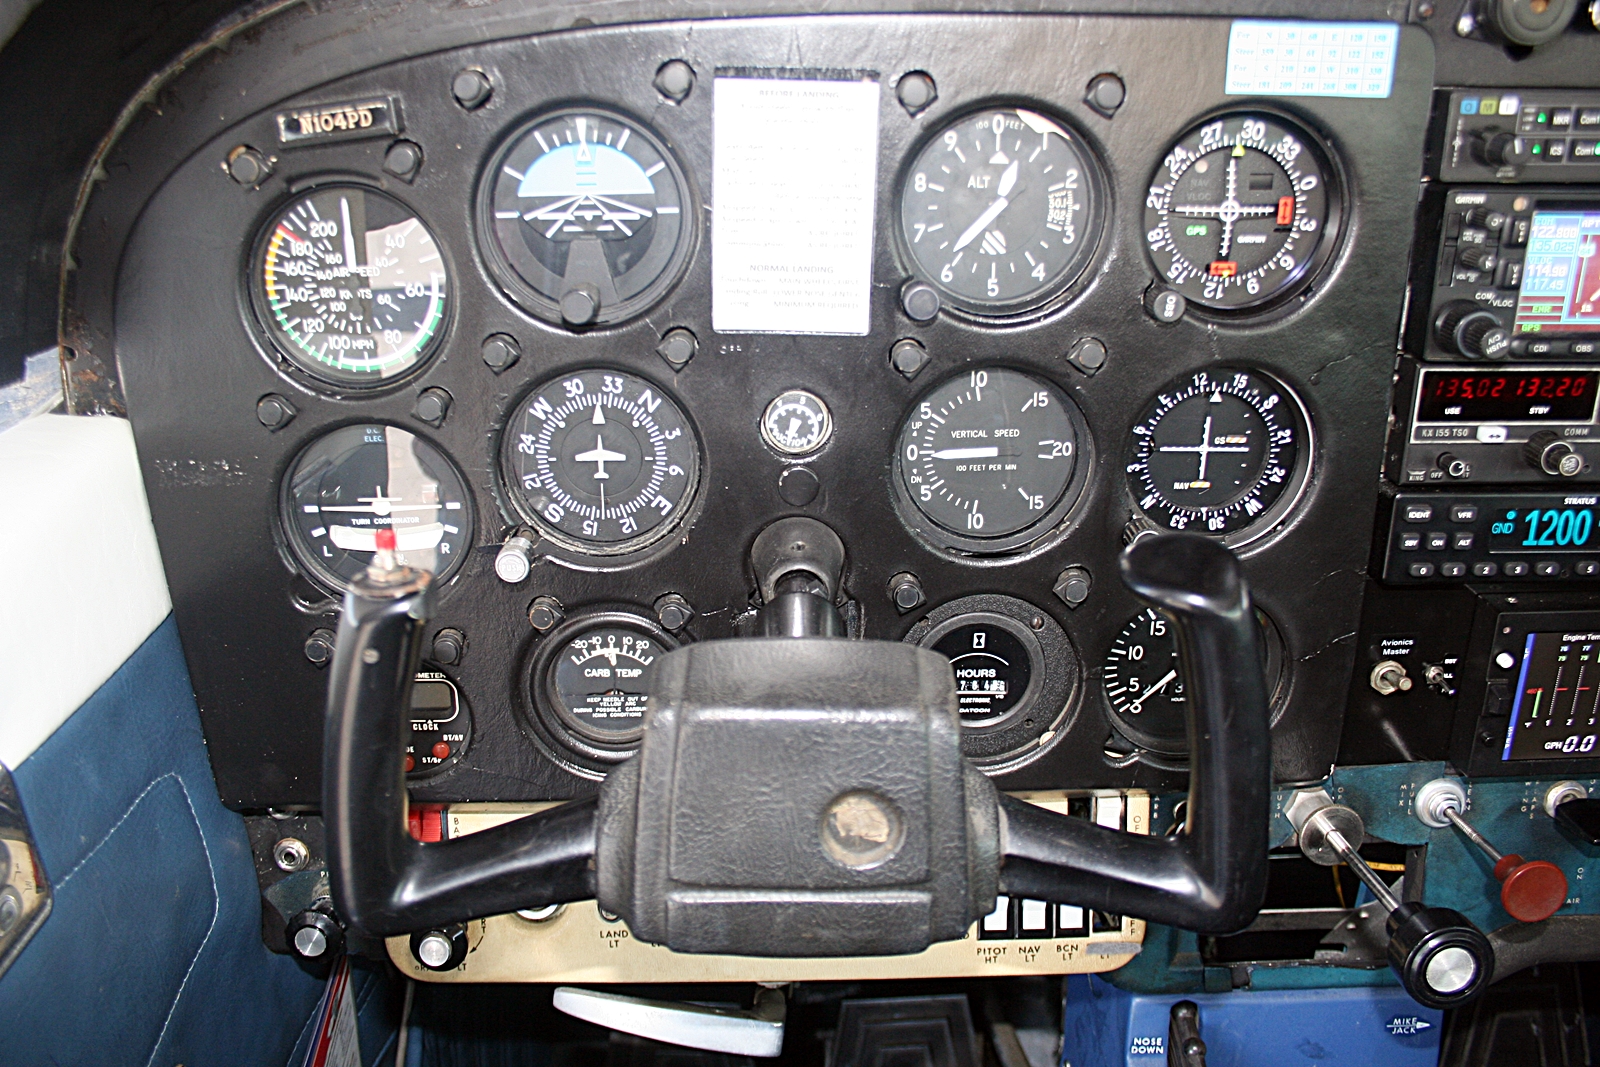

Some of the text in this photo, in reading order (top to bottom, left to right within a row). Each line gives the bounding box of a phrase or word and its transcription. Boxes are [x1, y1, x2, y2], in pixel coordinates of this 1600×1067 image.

[299, 113, 373, 134] N104PD
[975, 121, 989, 130] 100
[1005, 120, 1025, 130] FEET
[1553, 117, 1569, 125] MKR
[1200, 121, 1223, 146] 27
[1241, 119, 1265, 141] 30
[944, 130, 957, 151] 9
[1277, 135, 1301, 161] 33
[1549, 147, 1562, 156] ICS
[1164, 146, 1187, 173] 24
[914, 172, 927, 192] 8
[967, 175, 991, 189] ALT
[1065, 168, 1078, 189] 2
[1146, 186, 1166, 210] 21
[1455, 195, 1485, 204] GARMIN
[310, 221, 337, 237] 200
[914, 223, 926, 243] 7
[1063, 225, 1075, 244] 3
[1186, 225, 1208, 236] GPS
[385, 235, 405, 249] 40
[1147, 227, 1166, 252] 18
[1530, 240, 1575, 251] 135.025
[291, 241, 313, 256] 180
[1529, 256, 1553, 265] VLOC
[750, 264, 834, 274] NORMAL LANDING
[941, 264, 953, 283] 6
[1031, 263, 1046, 281] 4
[1167, 262, 1185, 284] 15
[406, 283, 425, 297] 60
[987, 278, 999, 297] 5
[1203, 281, 1224, 300] 12
[1525, 278, 1564, 291] 117.45
[330, 302, 346, 313] 100
[1164, 295, 1176, 318] OBS
[303, 318, 324, 333] 120
[1521, 324, 1541, 332] GPS
[329, 335, 374, 350] 100 MPH
[384, 330, 402, 344] 80
[602, 376, 624, 394] 33
[970, 371, 988, 387] 10
[1192, 372, 1209, 386] 12
[1233, 374, 1248, 389] 15
[563, 378, 584, 397] 30
[1436, 378, 1587, 399] 135.02 132.20
[638, 389, 662, 413] N
[1033, 392, 1048, 407] 15
[528, 397, 553, 421] W
[920, 403, 932, 419] 5
[1444, 406, 1461, 415] USE
[1528, 406, 1550, 415] STBY
[912, 421, 922, 429] UP
[1564, 428, 1589, 436] COMM
[364, 435, 384, 443] ELEC.
[665, 427, 681, 440] 3
[773, 429, 808, 447] SUCTION
[951, 429, 1020, 438] VERTICAL SPEED
[1276, 429, 1292, 445] 21
[1421, 429, 1433, 437] KX
[1452, 428, 1469, 436] TSO
[518, 433, 536, 455] 24
[1052, 442, 1072, 456] 20
[907, 445, 918, 460] 0
[522, 473, 542, 490] 21
[1268, 467, 1286, 483] 24
[920, 485, 932, 501] 5
[1174, 482, 1190, 490] NAV
[651, 495, 672, 516] E
[1029, 495, 1044, 509] 15
[1563, 497, 1597, 505] STRATUS
[544, 503, 564, 523] S
[1408, 511, 1431, 519] IDENT
[351, 516, 420, 526] TURN COORDINATOR
[582, 520, 598, 536] 15
[619, 516, 638, 534] 12
[967, 514, 984, 529] 10
[1491, 522, 1514, 534] GND
[1522, 509, 1593, 546] 1200
[1150, 621, 1166, 636] 15
[571, 639, 588, 649] -20
[588, 636, 602, 645] -10
[1381, 639, 1414, 647] Avionics
[1563, 634, 1586, 642] Engine
[1128, 645, 1144, 660] 10
[1382, 648, 1410, 656] Master
[584, 669, 642, 677] CARB TEMP
[956, 669, 997, 678] HOURS
[1128, 677, 1140, 692] 5
[413, 723, 439, 731] CLOCK
[1544, 736, 1596, 752] GPH 0.0
[600, 930, 628, 938] LAND
[609, 940, 619, 948] LT
[1019, 946, 1041, 954] NAV
[1056, 944, 1078, 952] BCN
[977, 947, 1007, 956] PITOT
[1393, 1018, 1418, 1026] MIKE
[1134, 1037, 1162, 1046] NOSE
[1131, 1046, 1164, 1055] DOWN
